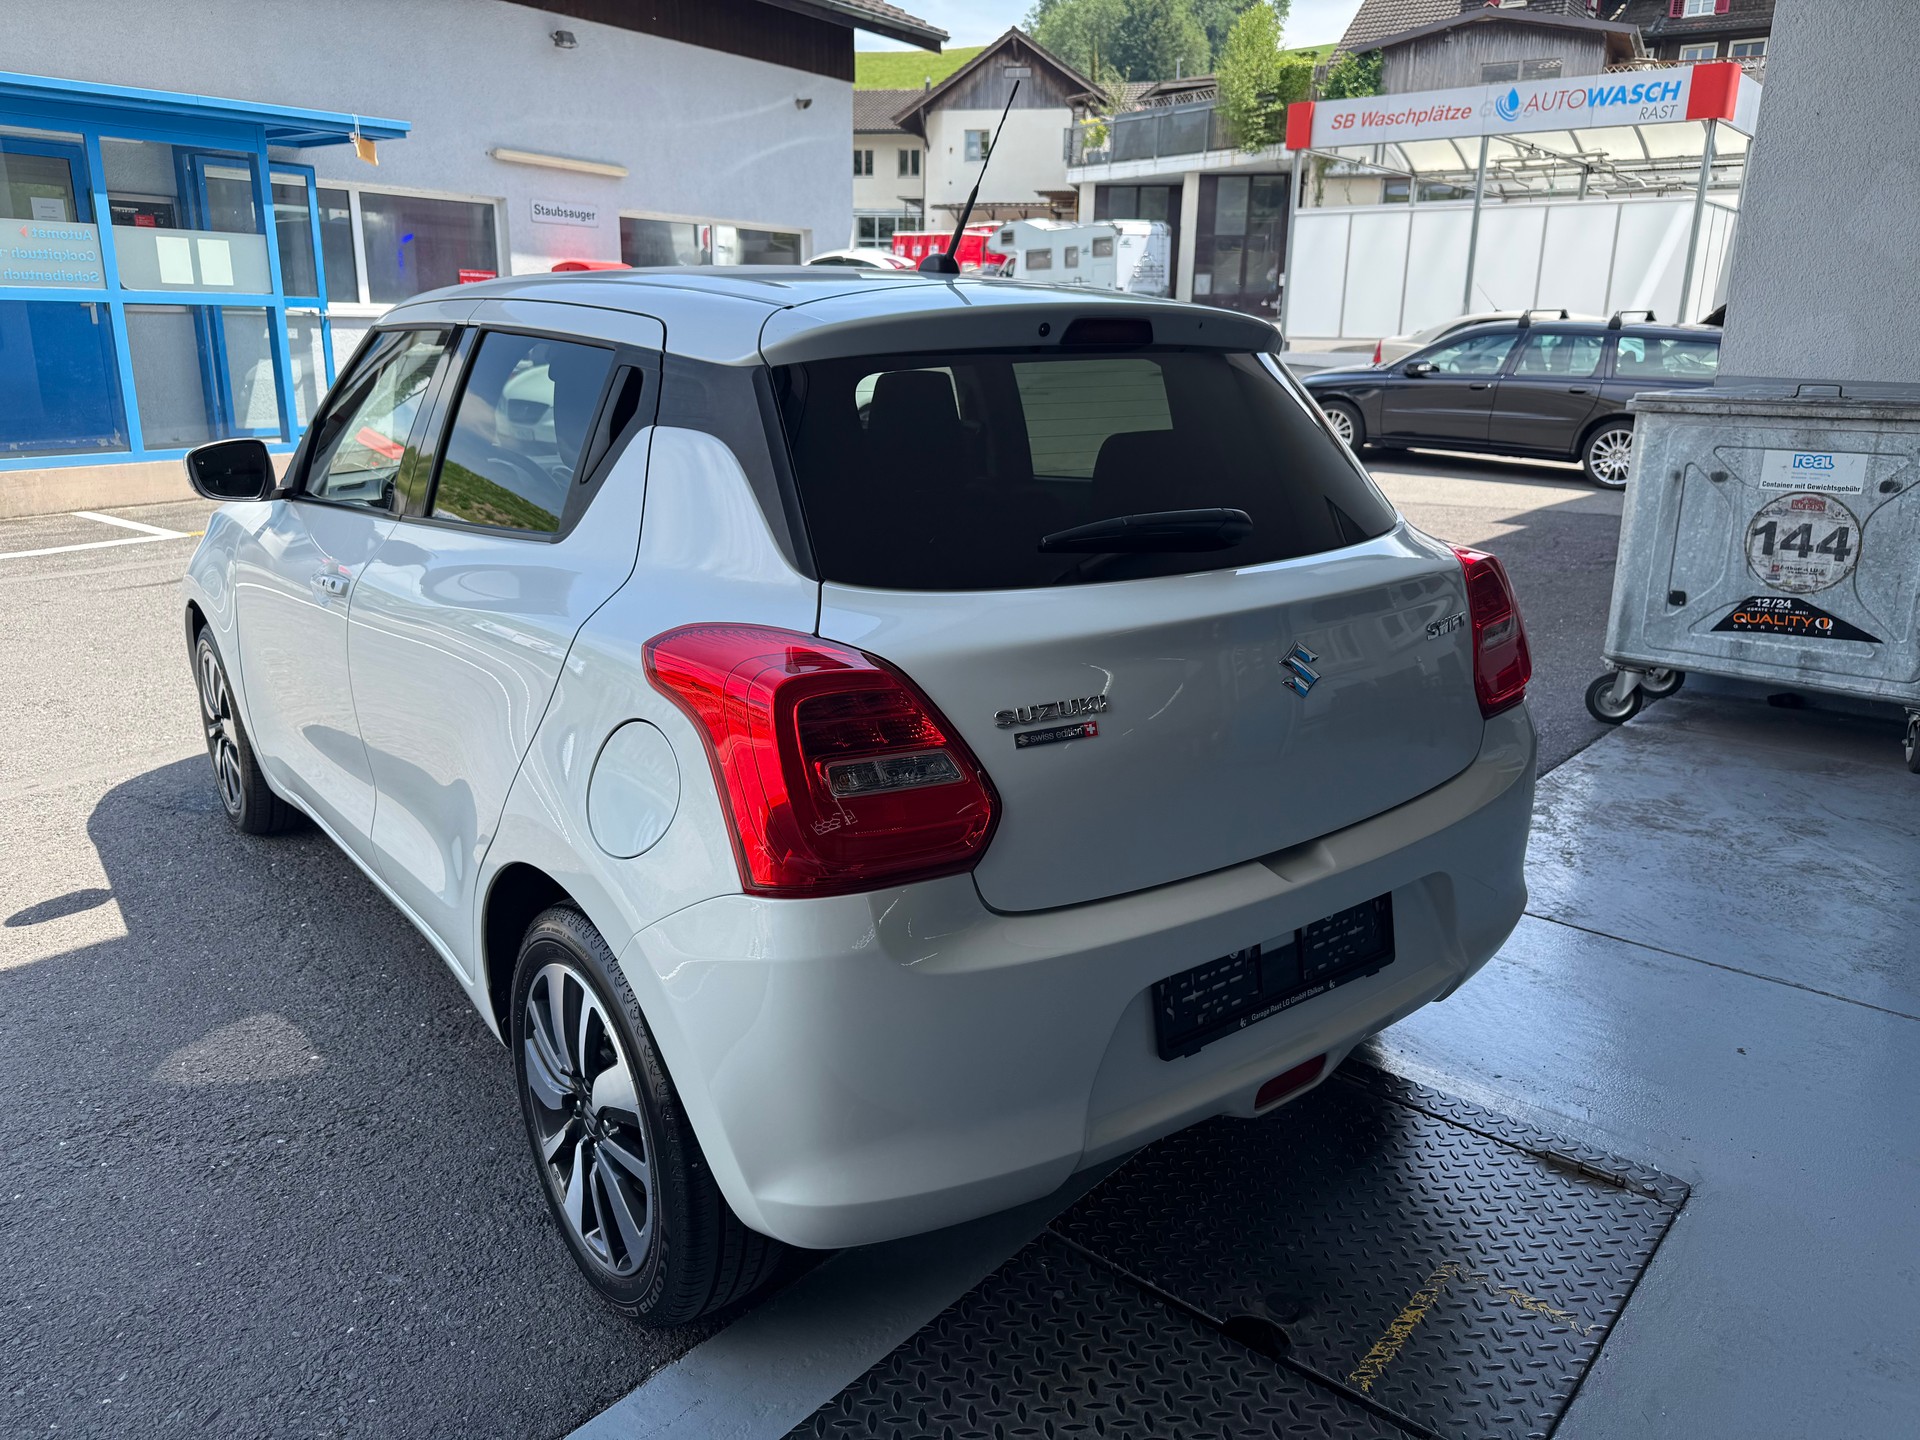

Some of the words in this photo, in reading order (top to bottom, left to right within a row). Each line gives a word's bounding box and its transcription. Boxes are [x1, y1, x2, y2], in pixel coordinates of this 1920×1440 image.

[1523, 80, 1682, 113] AUTOWASCH
[1331, 113, 1356, 130] SB
[1361, 105, 1472, 127] Waschplätze
[1638, 104, 1678, 121] RAST
[534, 204, 596, 222] Staubsauger
[1762, 481, 1793, 489] Container
[1807, 484, 1861, 493] Gewichtsgebühr
[1753, 521, 1852, 562] 144
[1755, 599, 1792, 609] 12/24
[1733, 613, 1815, 628] QUALITY
[1733, 624, 1832, 636] GARANTIE
[994, 695, 1107, 728] SUZUKI
[1030, 731, 1055, 743] swiss
[1055, 726, 1083, 739] edition
[1251, 1008, 1270, 1021] Garage
[1271, 1003, 1282, 1013] Rast
[1283, 998, 1290, 1007] LG
[1291, 992, 1307, 1004] GmbH
